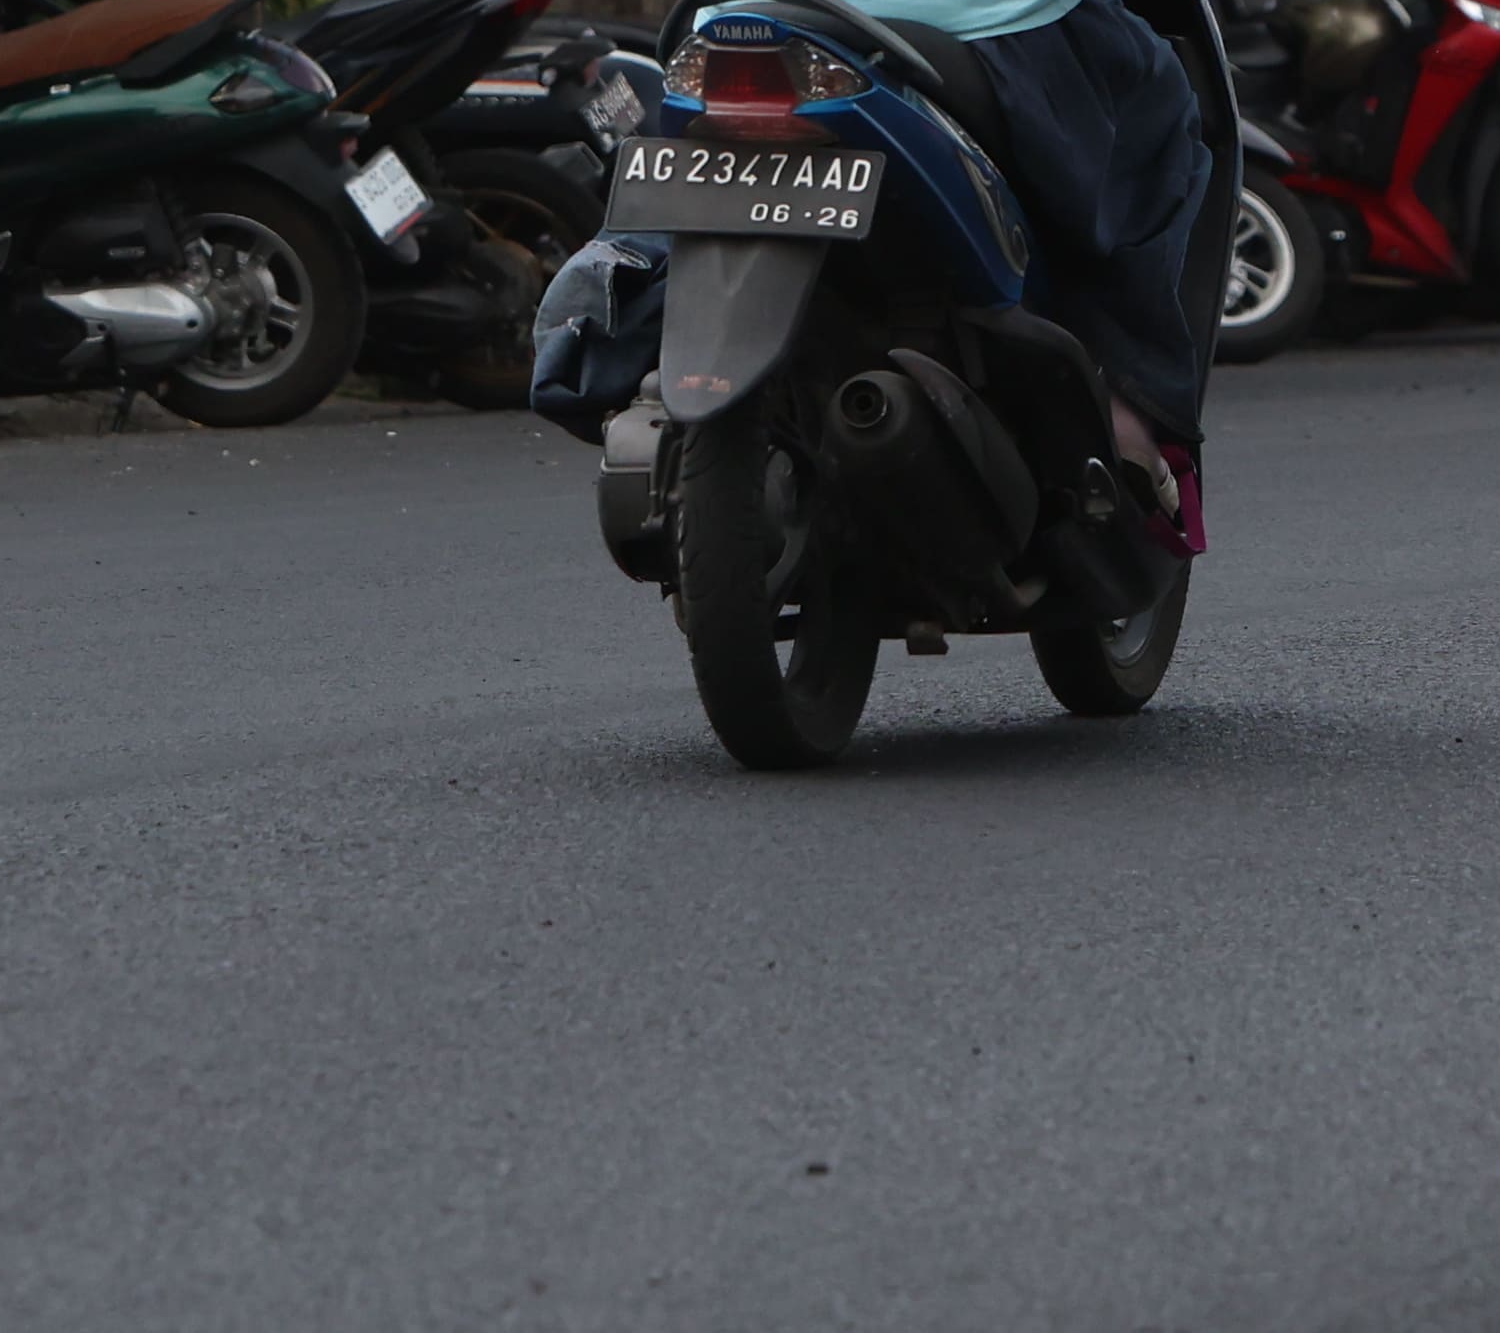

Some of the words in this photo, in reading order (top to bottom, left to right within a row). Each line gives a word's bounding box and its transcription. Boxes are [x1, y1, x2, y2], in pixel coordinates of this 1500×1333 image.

[713, 25, 773, 41] YAMAHA
[625, 147, 674, 182] AG
[686, 149, 789, 187] 2347
[793, 155, 872, 193] AAD
